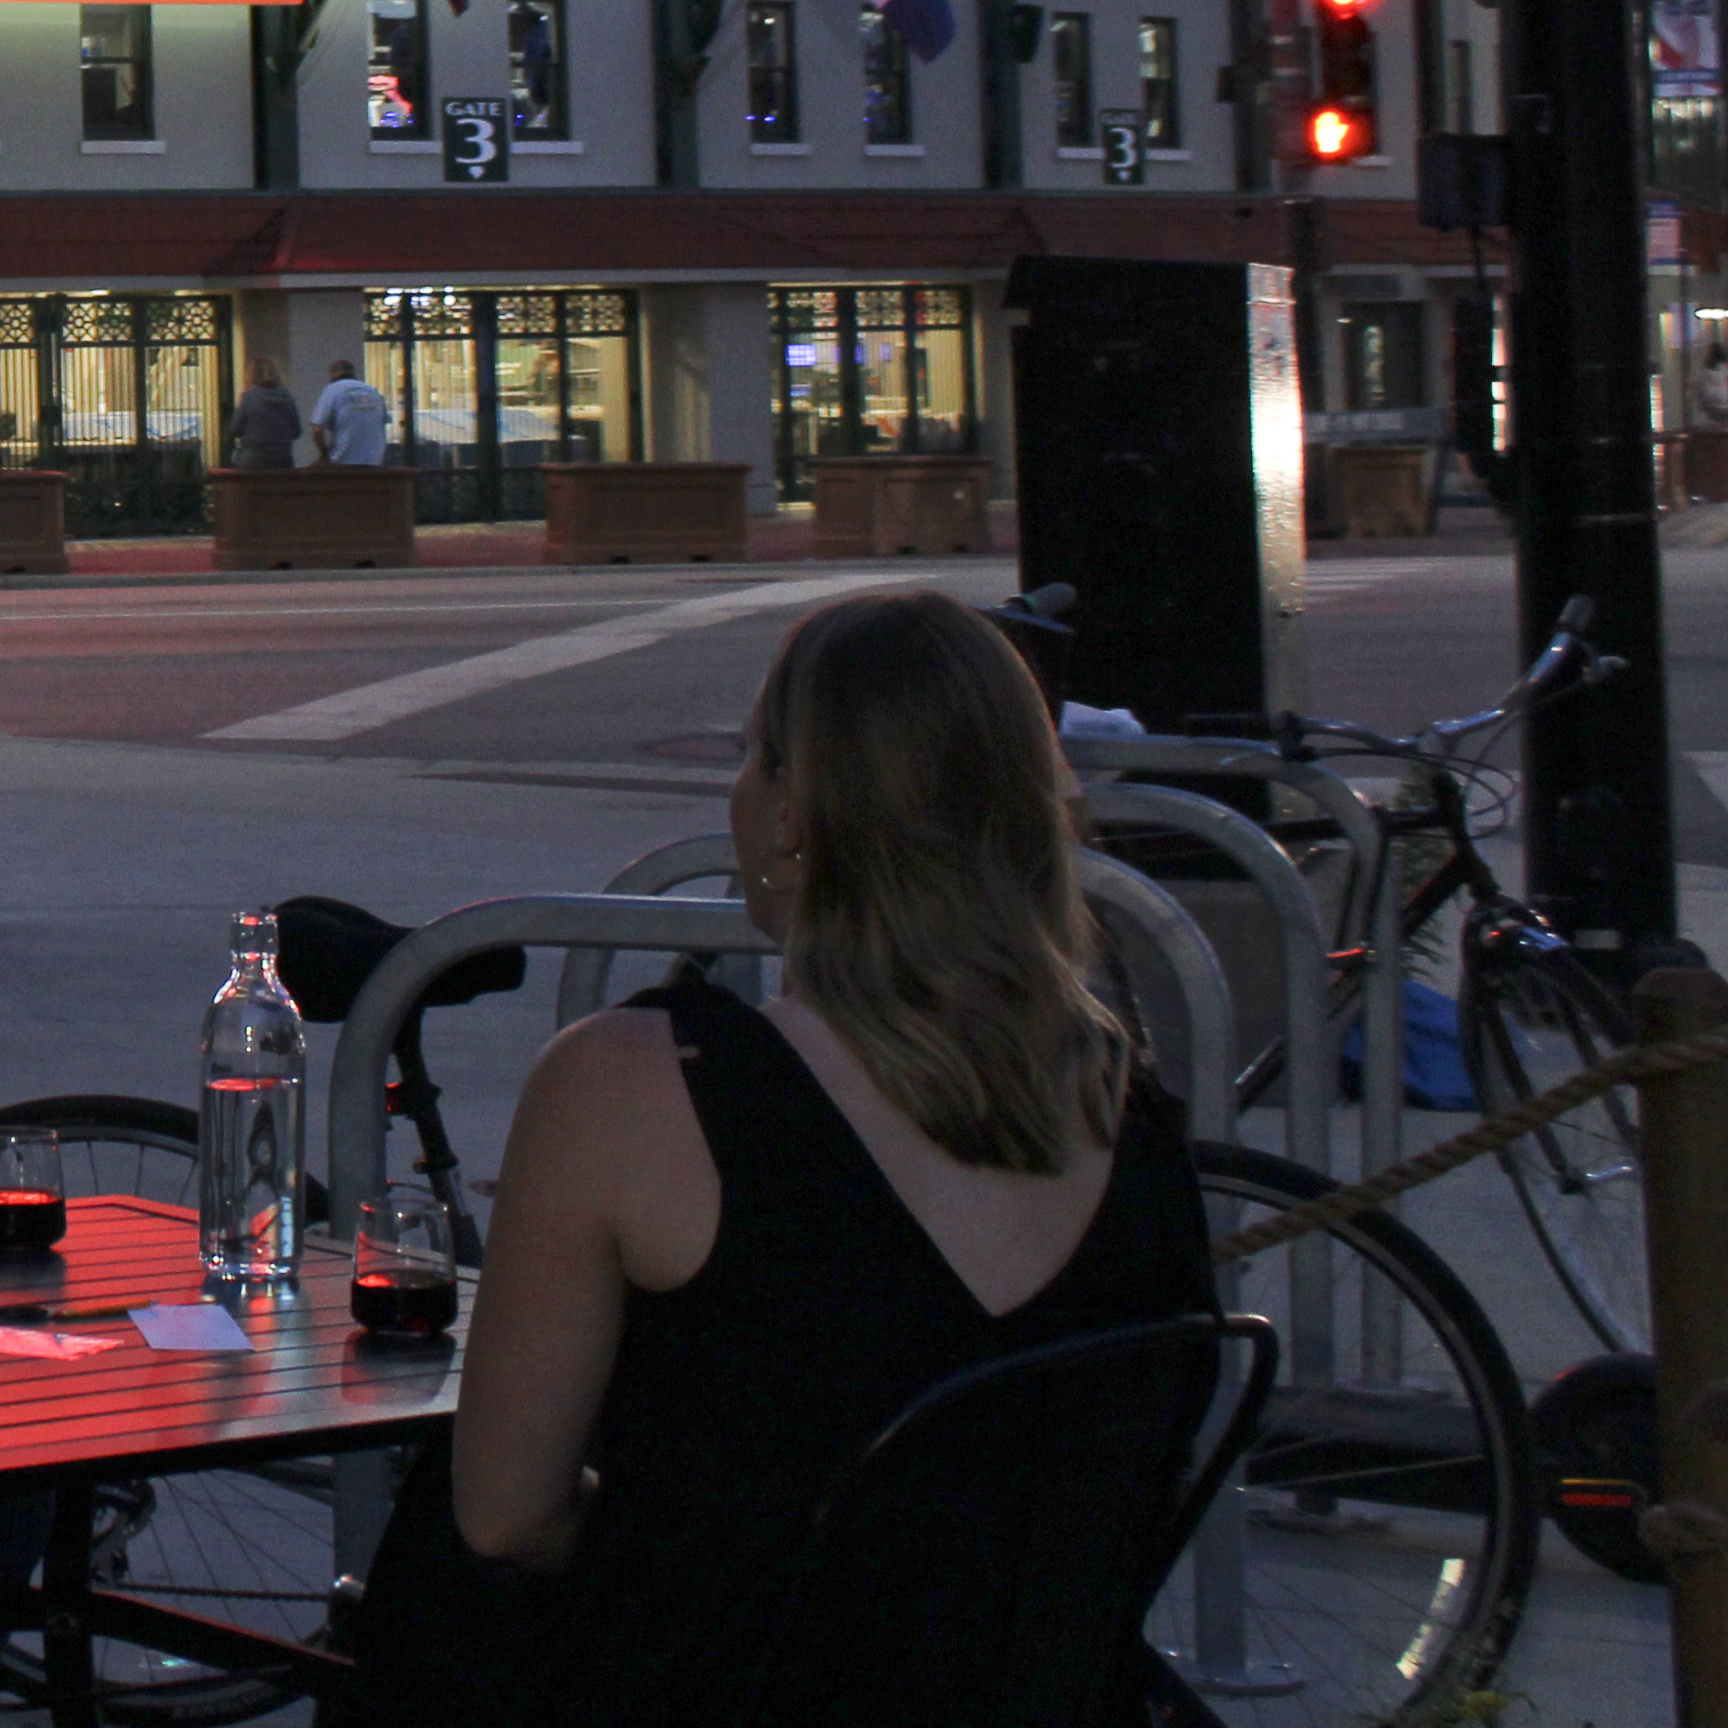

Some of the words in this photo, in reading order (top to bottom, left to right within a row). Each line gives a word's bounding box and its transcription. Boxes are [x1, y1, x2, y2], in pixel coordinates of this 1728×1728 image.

[444, 101, 502, 116] GATE
[454, 117, 497, 164] 3
[1108, 126, 1139, 169] 3
